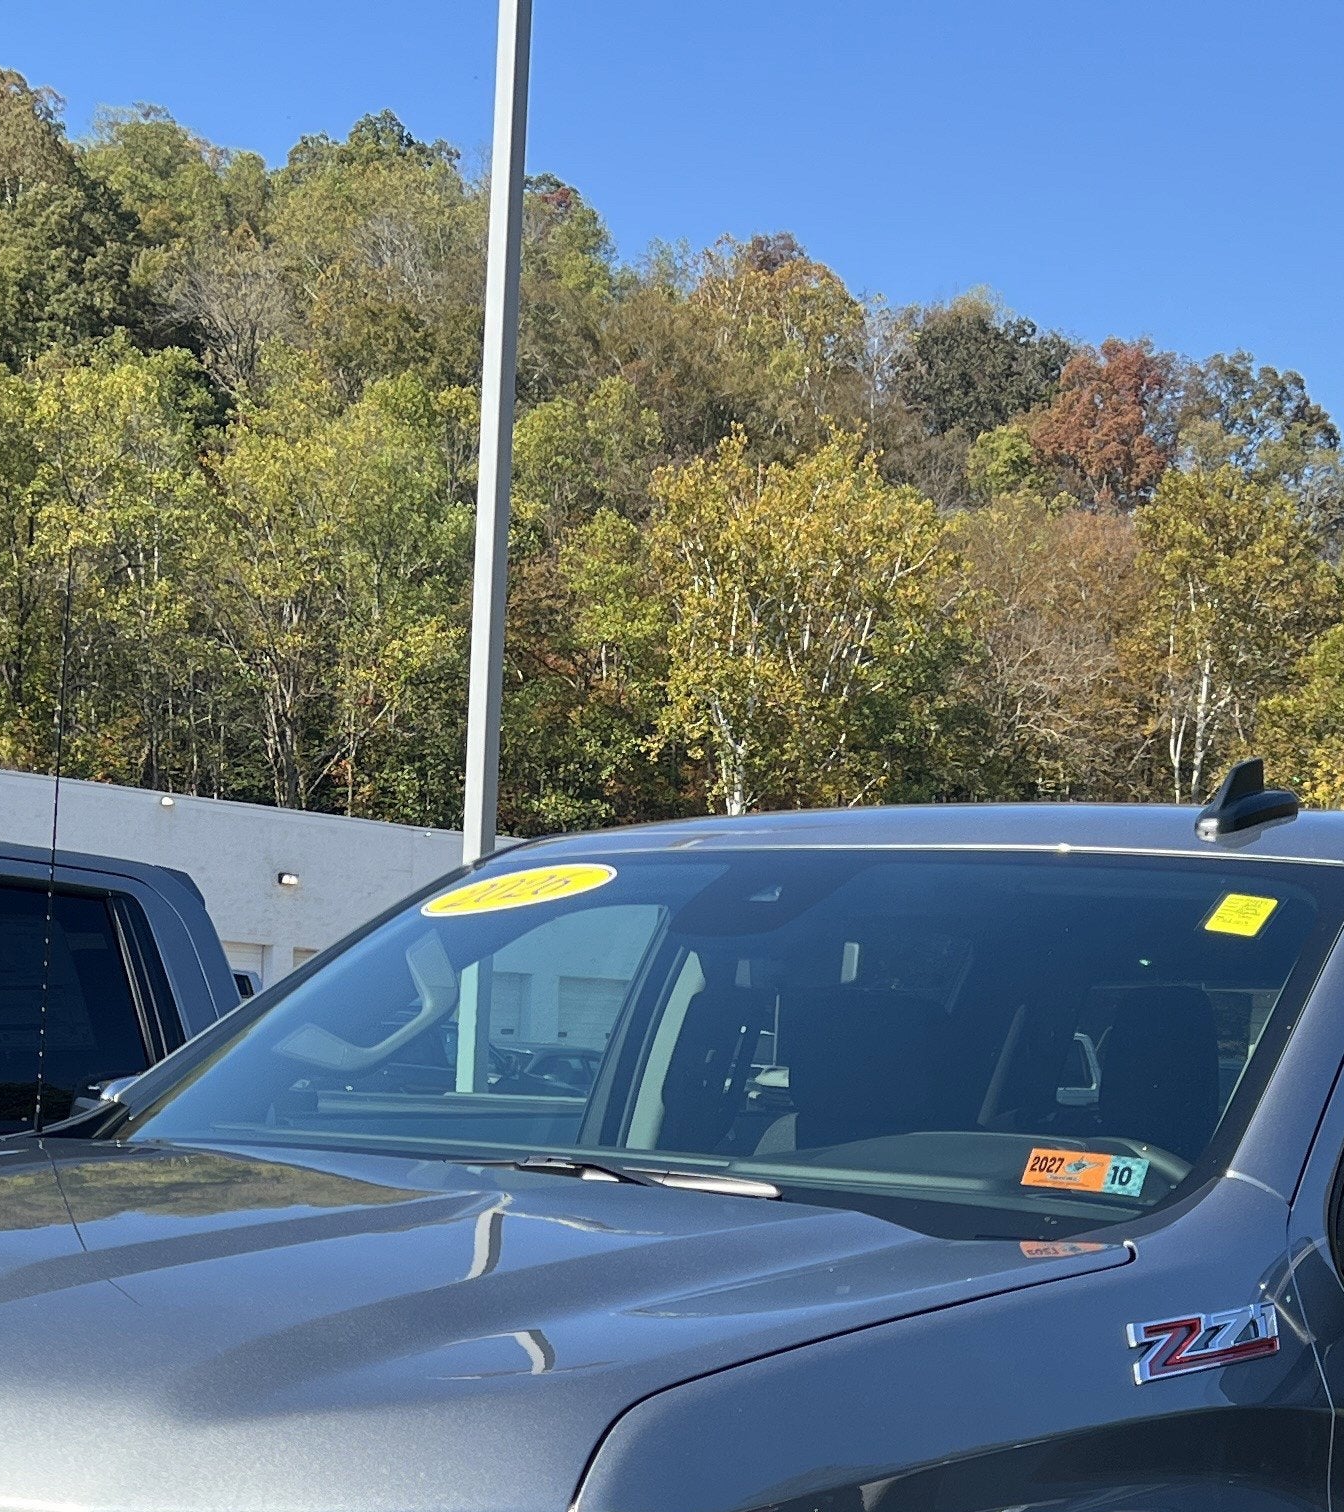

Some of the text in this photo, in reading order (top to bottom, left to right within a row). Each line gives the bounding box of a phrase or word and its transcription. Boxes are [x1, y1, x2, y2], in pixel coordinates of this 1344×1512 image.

[1029, 1156, 1065, 1173] 2027
[1111, 1165, 1132, 1186] 10
[1126, 1301, 1280, 1385] Z71
